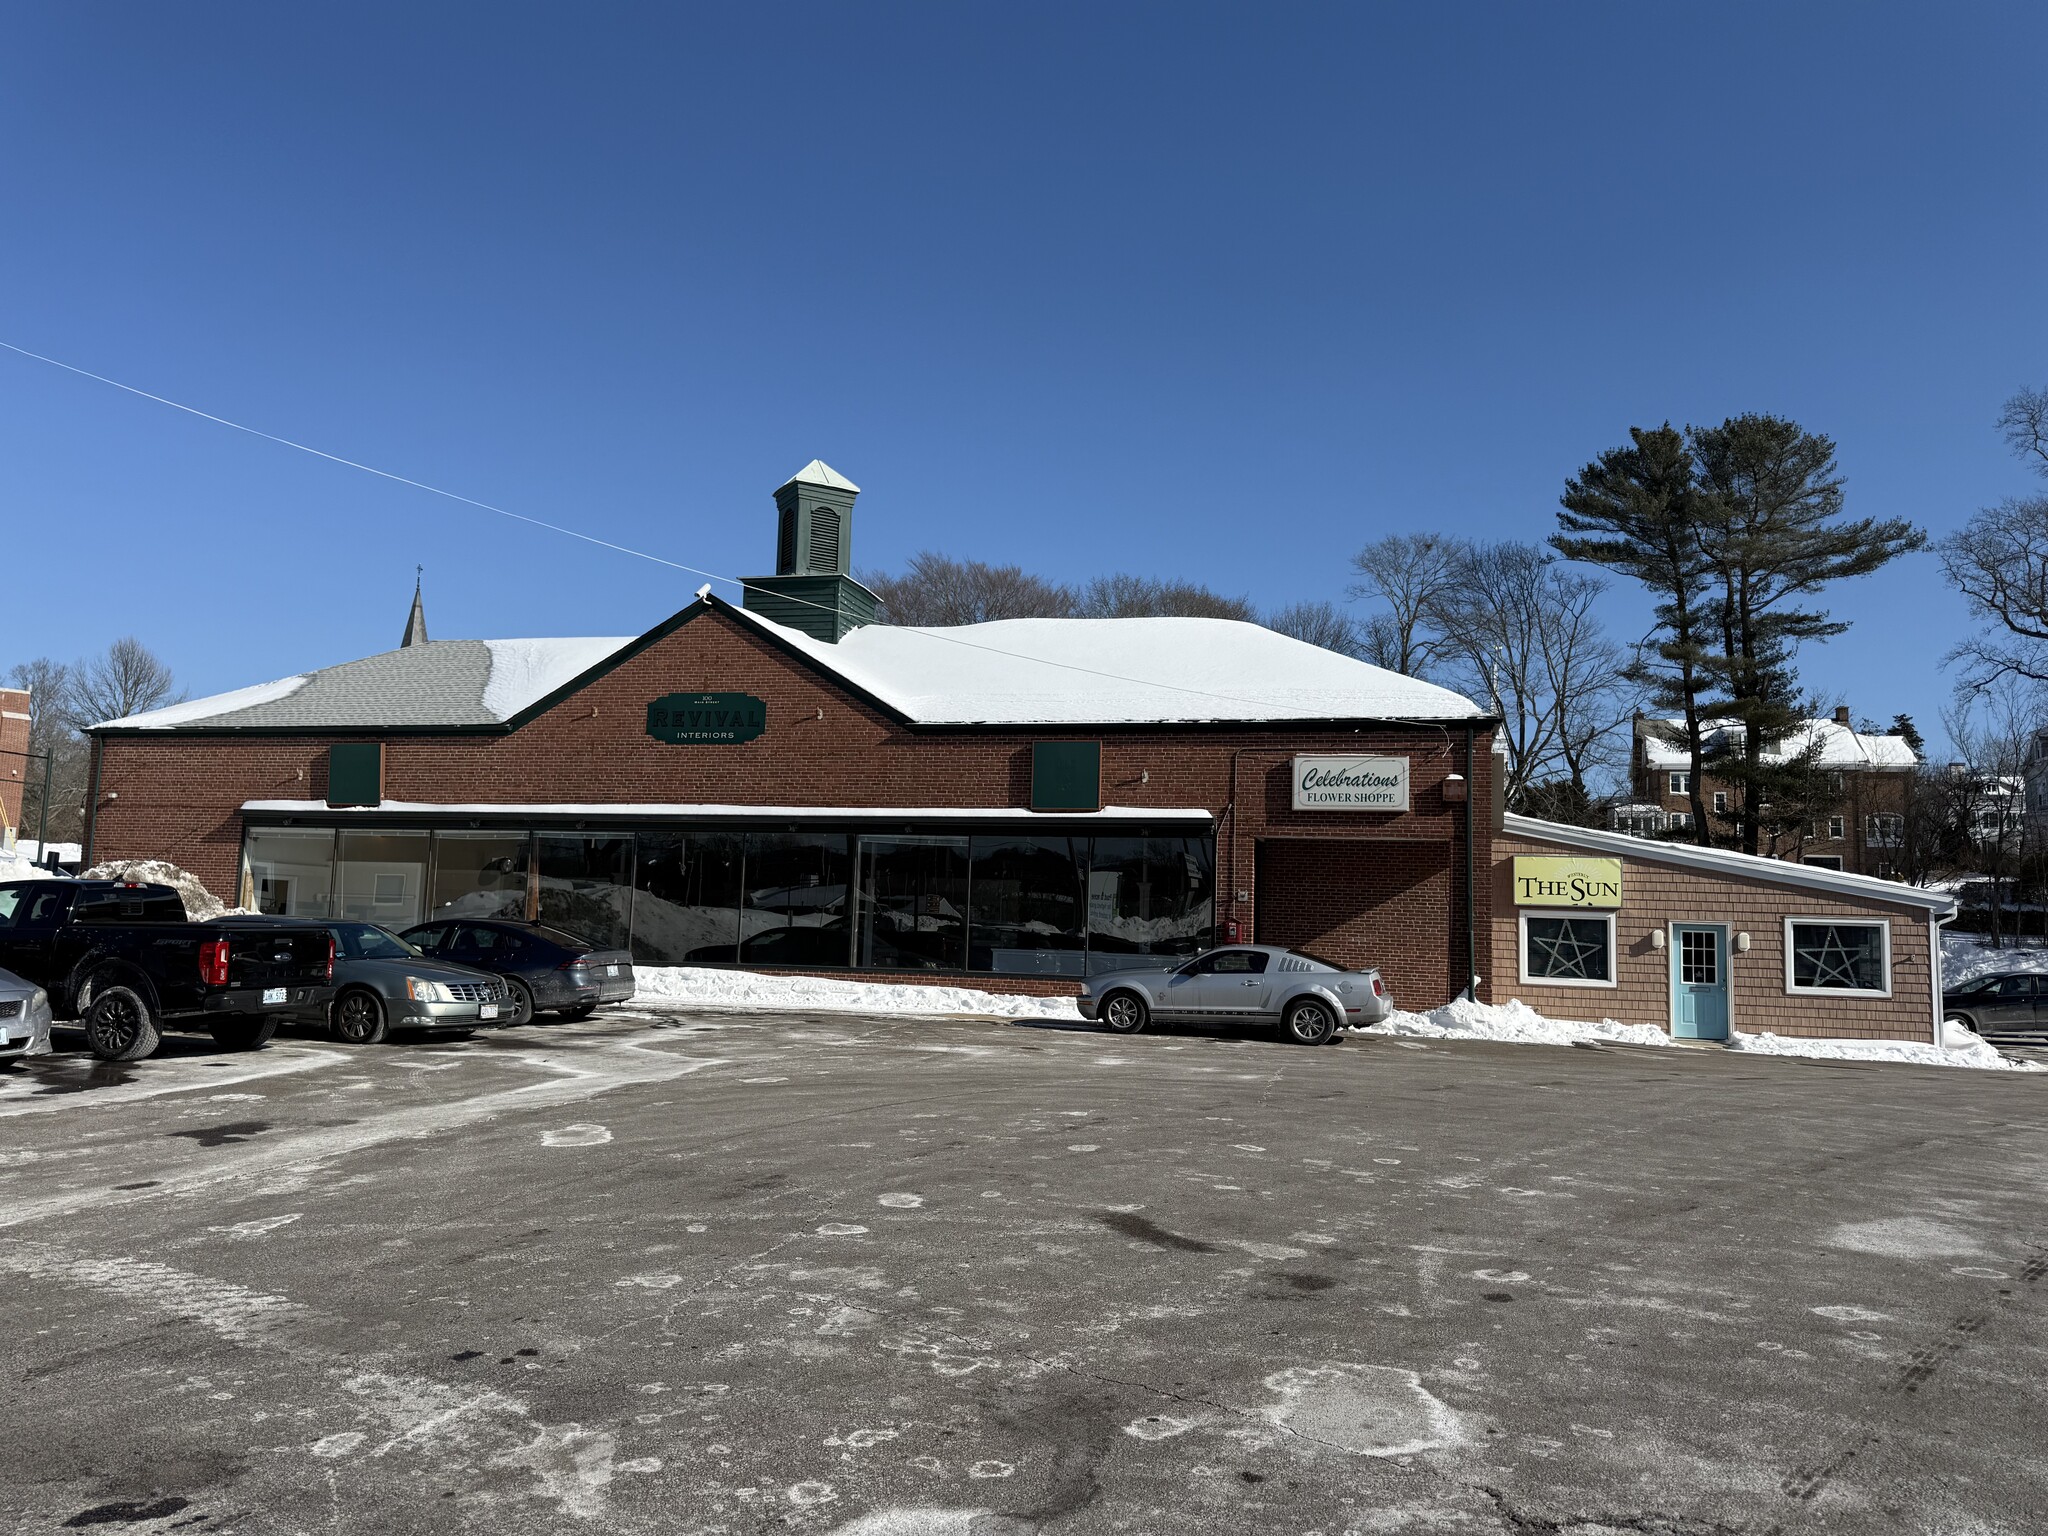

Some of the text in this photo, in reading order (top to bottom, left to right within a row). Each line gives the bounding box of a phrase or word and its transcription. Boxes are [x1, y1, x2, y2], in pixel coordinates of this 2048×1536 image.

[652, 708, 760, 728] REVIVAL
[1301, 767, 1398, 791] Celebrations
[1307, 792, 1396, 803] FLOWER SHOPPE
[1518, 877, 1619, 902] THE SUN
